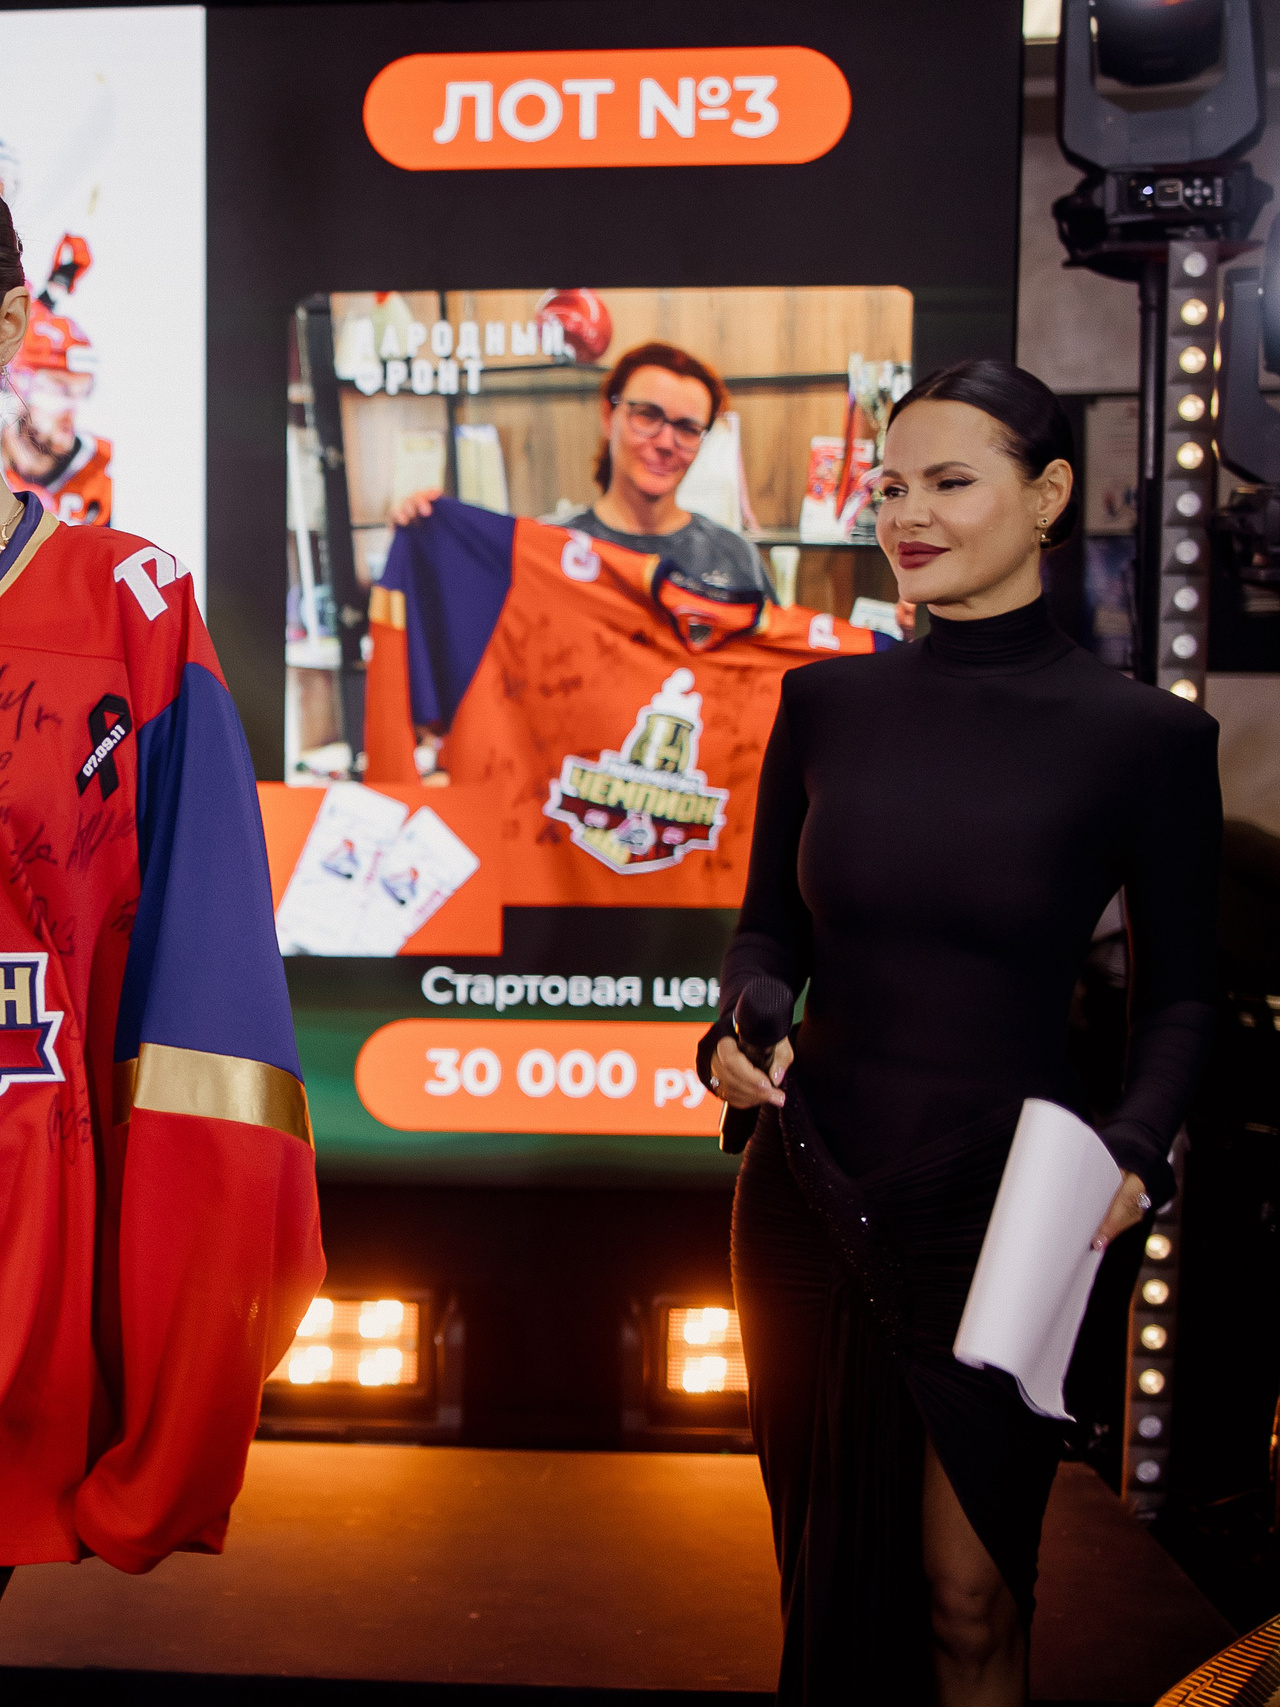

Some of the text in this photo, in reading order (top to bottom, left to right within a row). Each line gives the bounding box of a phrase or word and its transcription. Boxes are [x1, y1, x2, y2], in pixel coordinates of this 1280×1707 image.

[433, 75, 778, 143] ЛОТ №3
[83, 725, 126, 777] 07.09.11
[421, 966, 642, 1011] Стартовая
[424, 1048, 501, 1097] 30
[517, 1048, 637, 1099] 000
